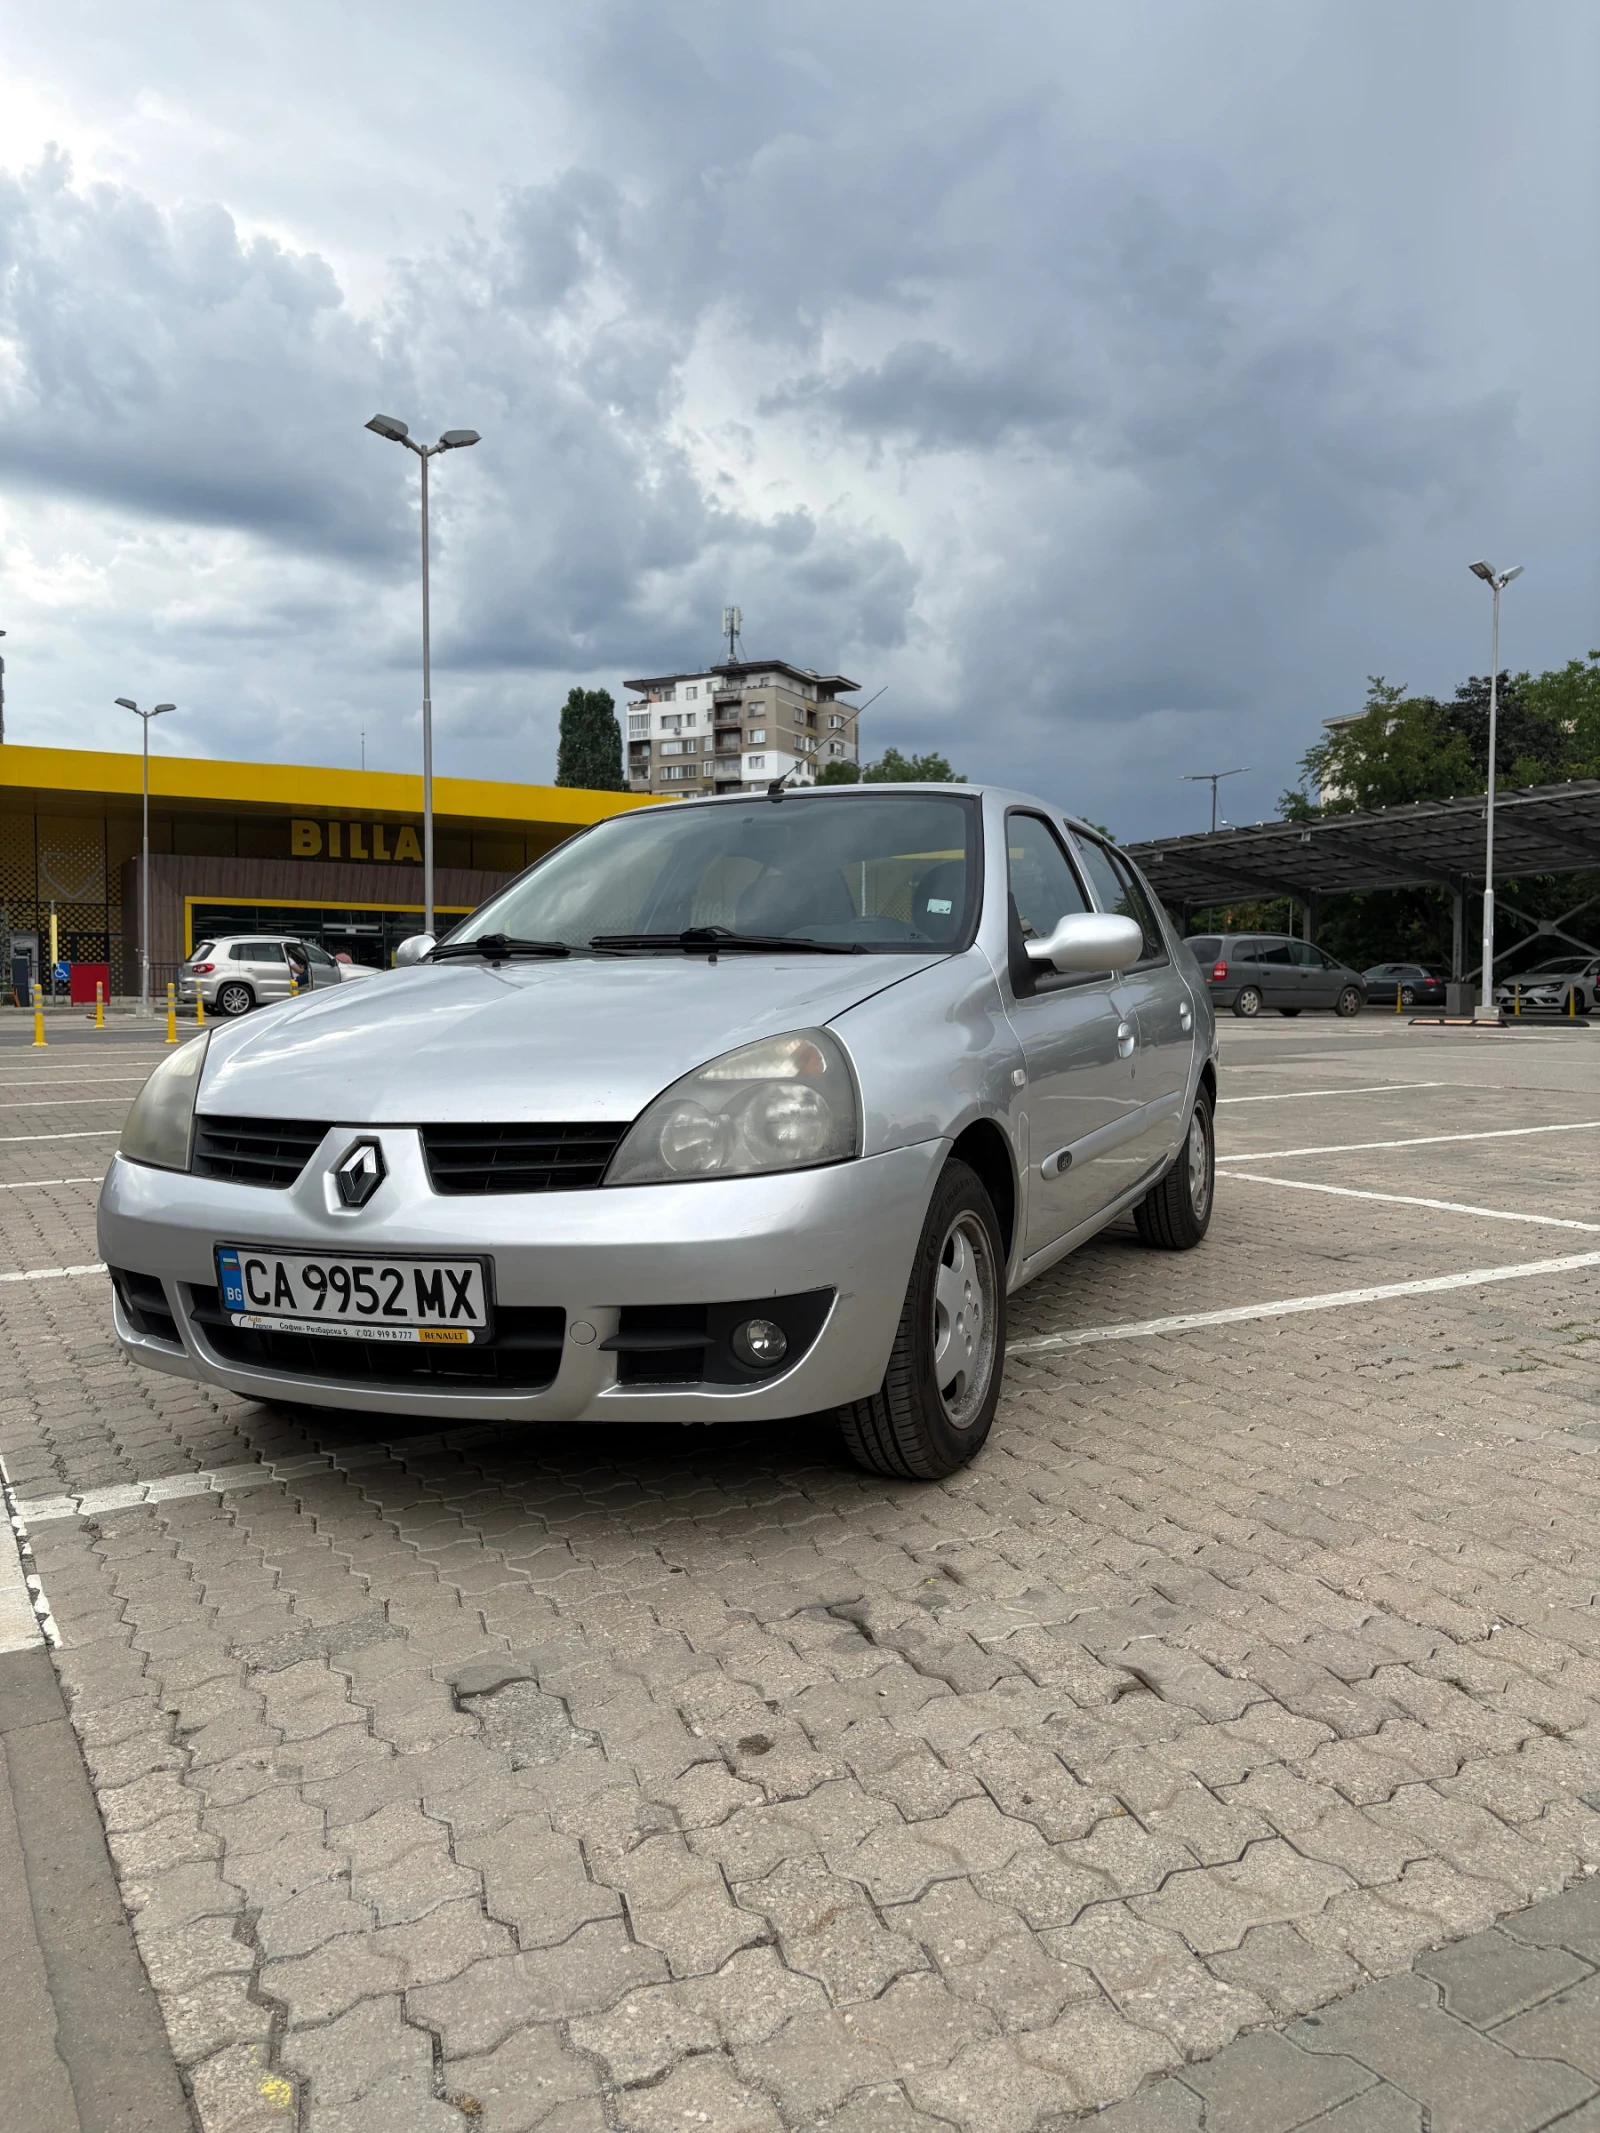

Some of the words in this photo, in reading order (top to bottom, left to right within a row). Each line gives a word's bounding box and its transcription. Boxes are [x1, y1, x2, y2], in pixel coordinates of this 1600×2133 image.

[291, 819, 423, 862] BILLA
[226, 1287, 243, 1302] BG
[244, 1258, 298, 1310] CA
[301, 1263, 408, 1317] 9952
[413, 1267, 478, 1320] MX
[398, 1331, 412, 1339] 777
[424, 1331, 464, 1341] RENAULT
